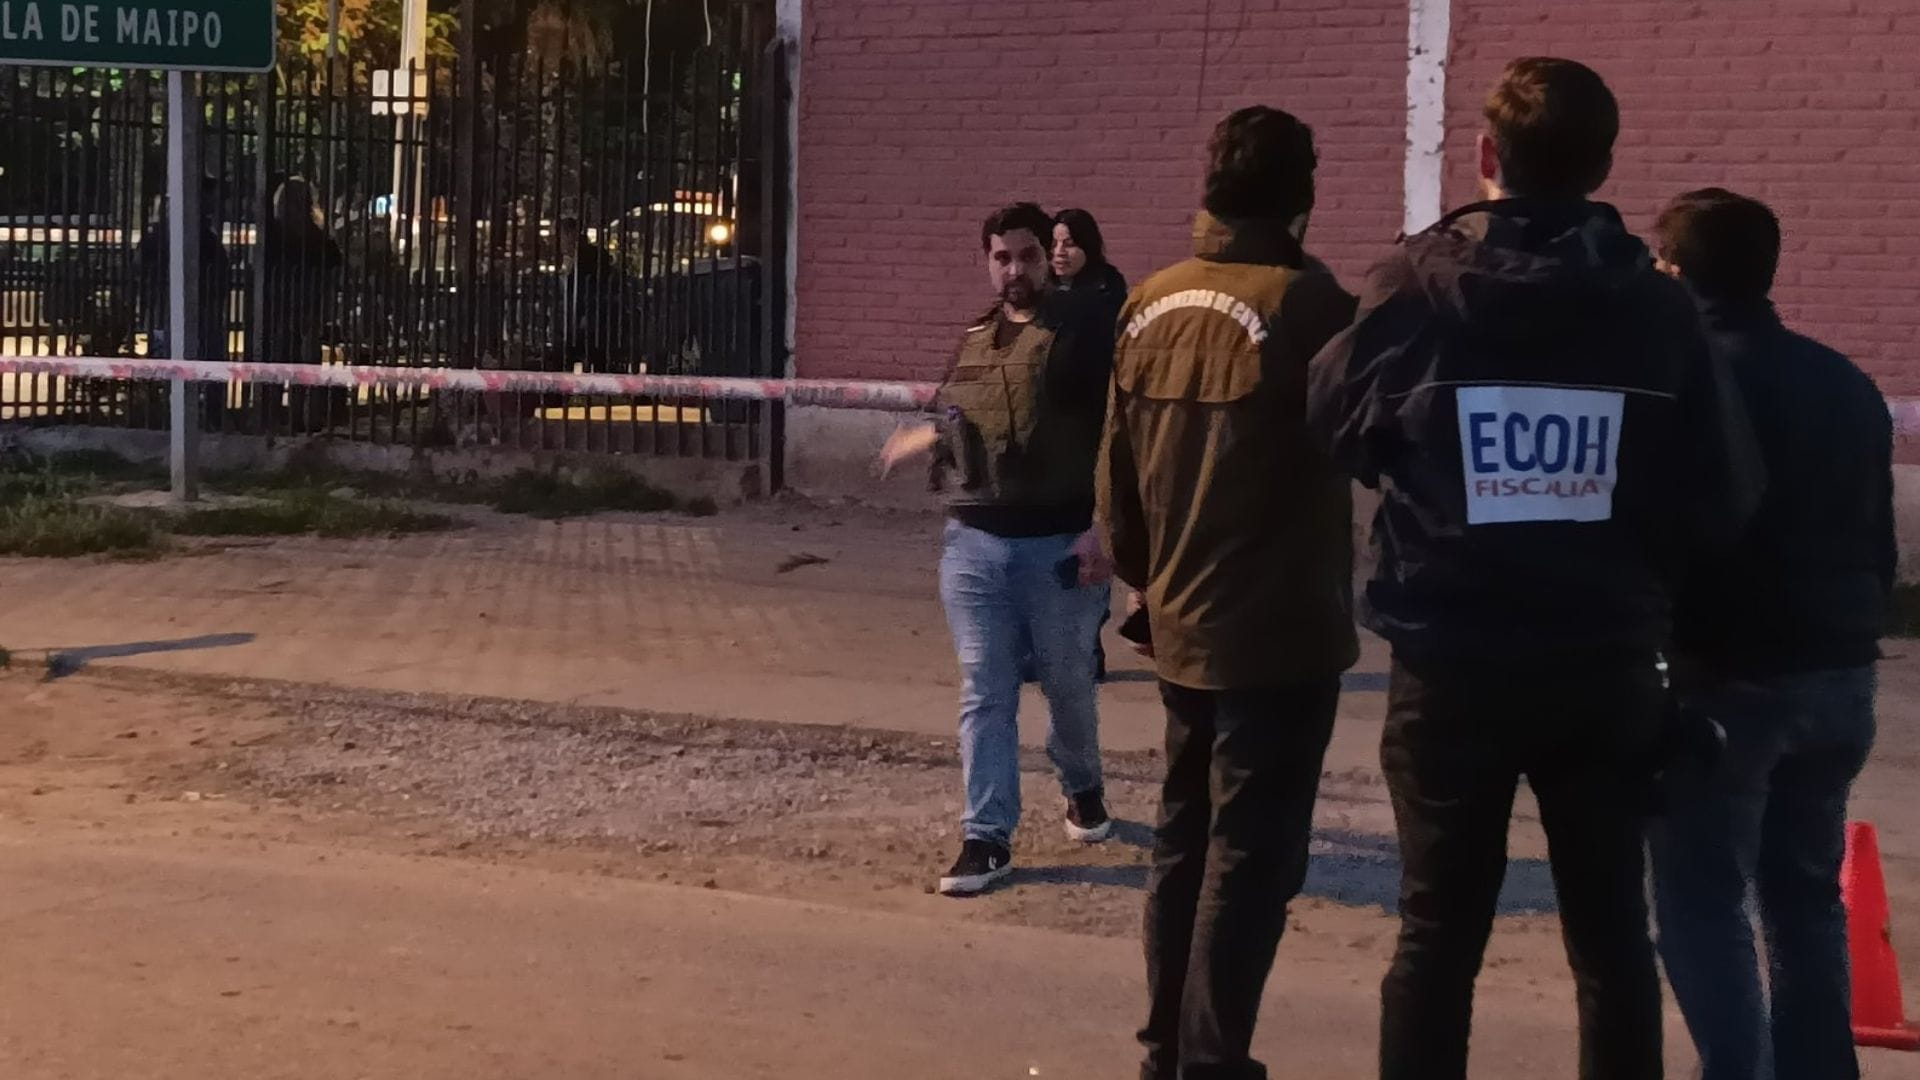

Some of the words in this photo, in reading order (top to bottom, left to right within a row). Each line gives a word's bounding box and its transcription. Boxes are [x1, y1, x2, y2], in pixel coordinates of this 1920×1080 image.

[61, 4, 99, 43] DE
[116, 7, 222, 48] MAIPO
[1469, 412, 1609, 475] ECOH
